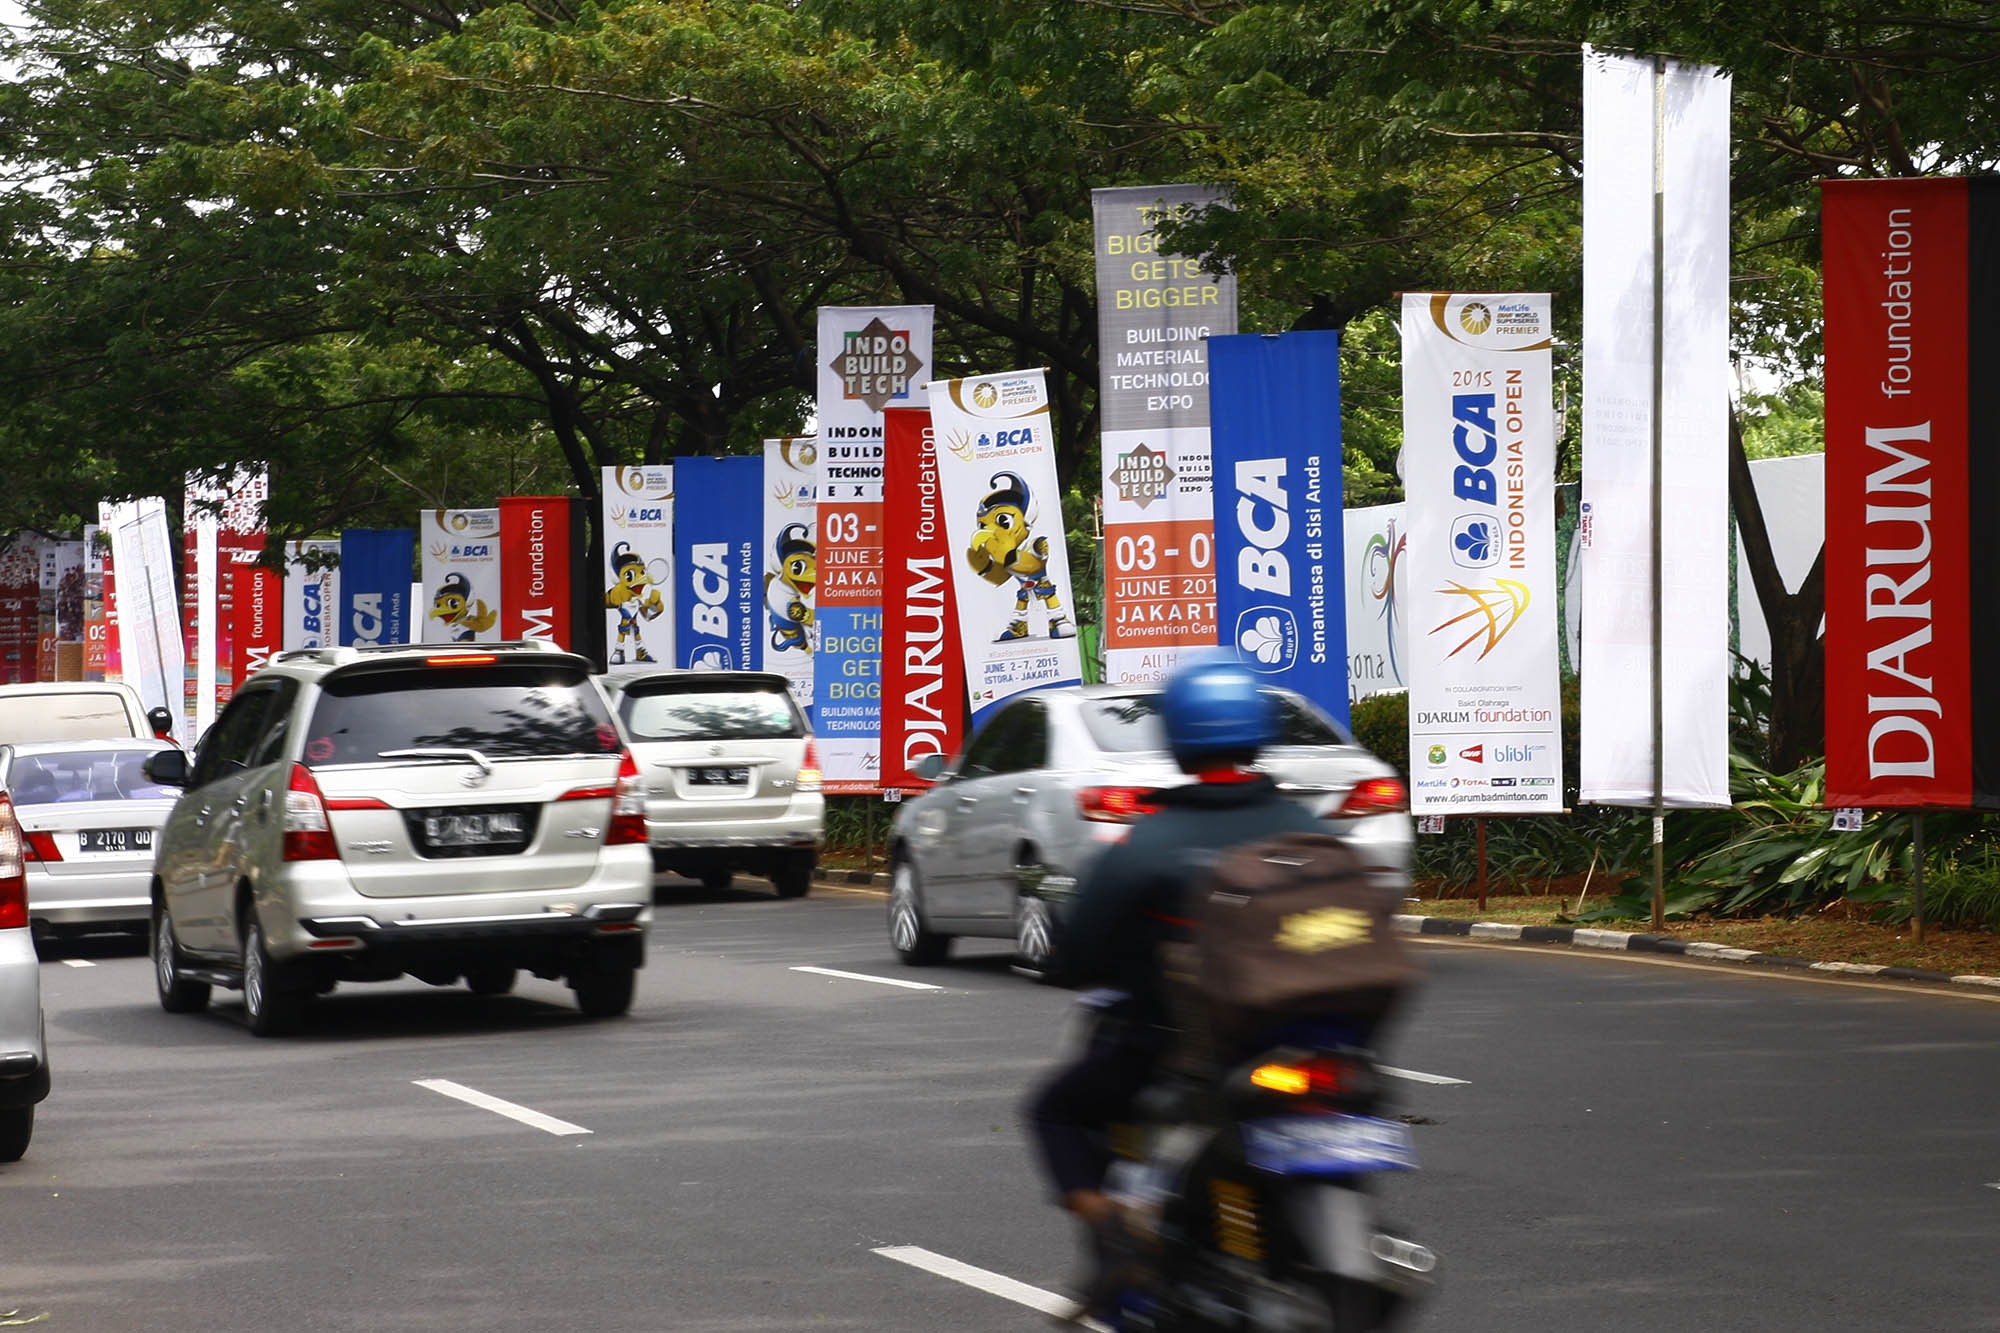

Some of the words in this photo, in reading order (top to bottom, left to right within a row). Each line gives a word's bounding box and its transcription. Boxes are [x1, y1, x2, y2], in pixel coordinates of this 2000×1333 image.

[1131, 259, 1201, 280] GETS
[1116, 286, 1219, 309] BIGGER
[1881, 208, 1912, 398] foundation
[1127, 326, 1210, 344] BUILDING
[1496, 326, 1539, 334] PREMIER
[845, 335, 906, 355] INDO
[844, 355, 907, 374] BUILD
[1117, 350, 1204, 367] MATERIAL
[844, 375, 906, 395] TECH
[1453, 370, 1492, 387] 2015
[1002, 396, 1038, 405] PREMIER
[1147, 395, 1193, 411] EXPO
[1506, 369, 1523, 433] OPEN
[828, 427, 882, 438] INDON
[995, 428, 1033, 447] BCA
[828, 447, 883, 458] BUILD
[976, 448, 1019, 459] INDONESIA
[1020, 445, 1043, 454] OPEN
[1452, 393, 1497, 506] BCA
[1119, 455, 1164, 470] INDO
[827, 467, 884, 479] TECHNO
[1120, 469, 1165, 483] BUILD
[1303, 456, 1321, 502] Anda
[828, 486, 884, 496] EX
[916, 427, 936, 541] foundation
[1120, 483, 1165, 497] TECH
[1507, 441, 1525, 568] INDONESIA
[640, 508, 662, 521] BCA
[1305, 506, 1322, 539] Sisi
[826, 512, 859, 543] 03
[1235, 458, 1291, 597] BCA
[463, 545, 488, 556] BCA
[528, 509, 544, 597] foundation
[739, 542, 752, 575] Anda
[824, 550, 869, 564] JUNE
[1115, 534, 1157, 571] 03
[1190, 533, 1215, 568] 0
[1305, 542, 1324, 560] di
[824, 571, 883, 586] JAKA
[691, 542, 730, 639] BCA
[740, 576, 751, 599] Sisi
[824, 587, 882, 598] Convention
[1115, 580, 1171, 597] JUNE
[252, 572, 264, 639] foundation
[304, 583, 322, 633] BCA
[740, 601, 751, 614] di
[1866, 420, 1943, 780] DJARUM
[1115, 602, 1217, 623] JAKART
[1307, 561, 1326, 663] Senantiasa
[849, 613, 883, 630] TH
[1116, 624, 1188, 637] Convention
[1192, 622, 1216, 634] Cen
[740, 619, 752, 671] nantiasa
[825, 636, 883, 654] BIGG
[903, 555, 948, 772] DJARUM
[984, 662, 1005, 674] JUNE
[1036, 656, 1059, 668] 2015
[1141, 654, 1161, 668] All
[983, 674, 1013, 685] ISTORA
[1020, 668, 1060, 681] JAKARTA
[1120, 672, 1150, 683] Open
[1152, 670, 1174, 682] Sp
[830, 682, 881, 699] BIGG
[821, 707, 863, 717] BUILDING
[1478, 699, 1510, 708] Olahraga
[1417, 712, 1470, 724] DJARUM
[1474, 708, 1552, 722] foundation
[826, 720, 881, 731] TECHNOLOG
[1417, 779, 1447, 788] MetLife
[1425, 793, 1548, 804] www.djarumbadminton.com
[80, 832, 88, 846] B
[97, 831, 125, 846] 2170
